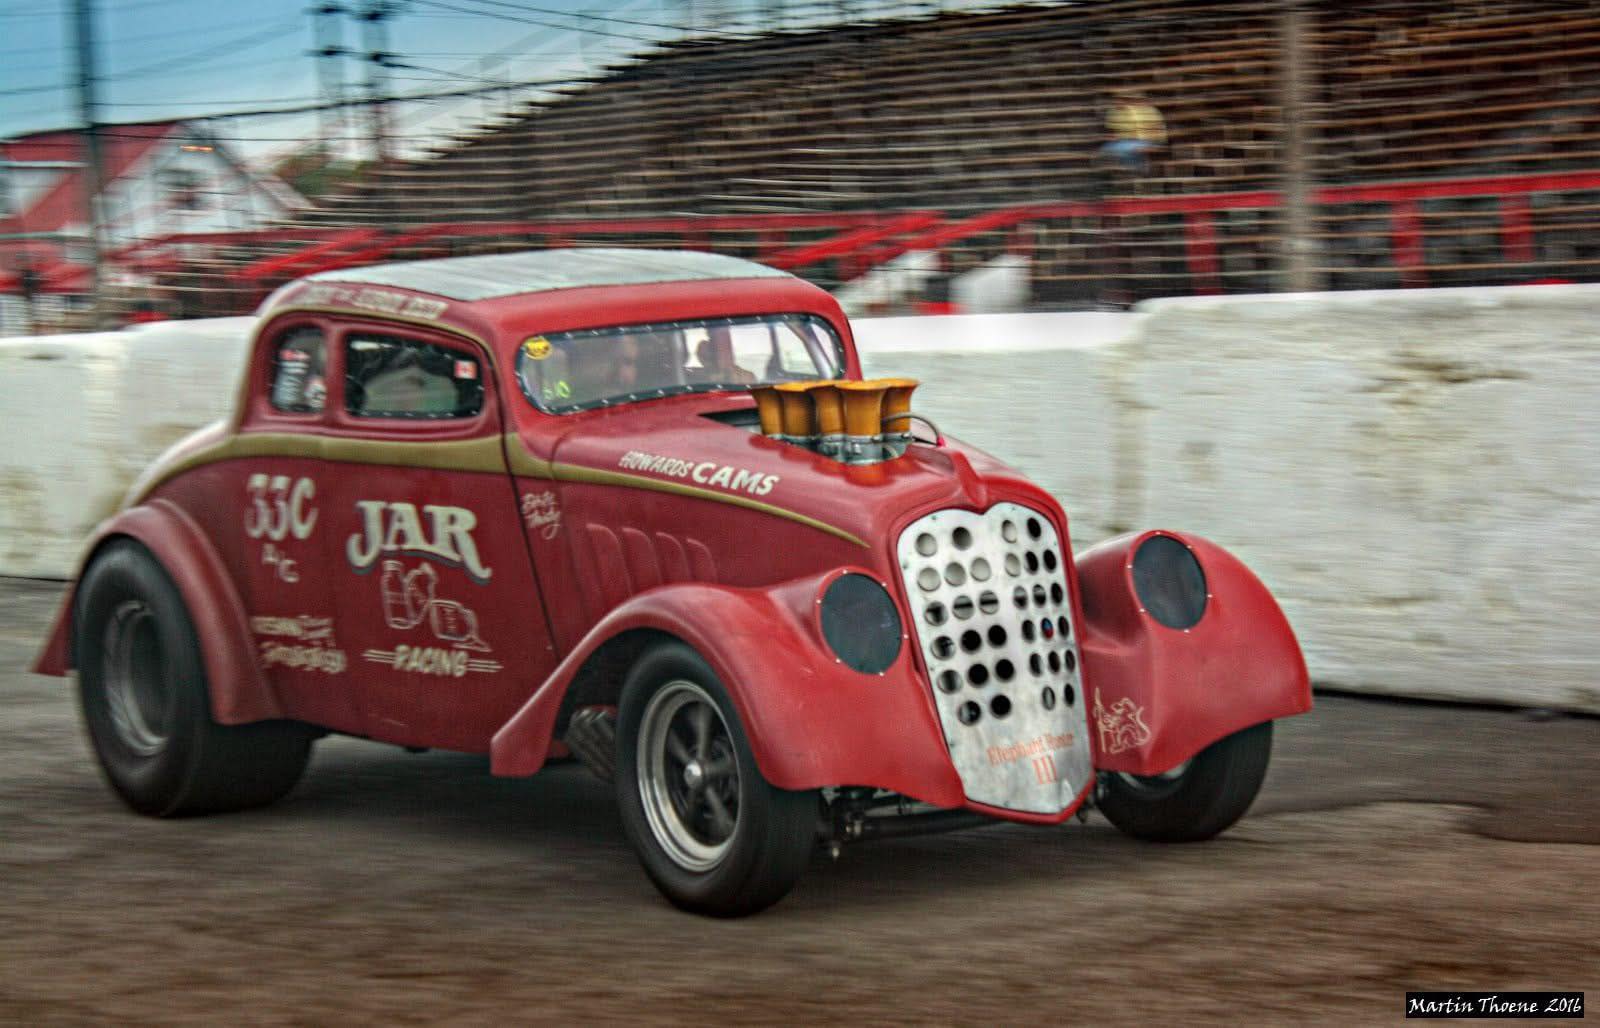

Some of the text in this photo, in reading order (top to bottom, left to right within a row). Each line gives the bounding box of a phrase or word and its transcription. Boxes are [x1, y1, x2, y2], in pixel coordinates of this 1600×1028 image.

[618, 451, 781, 496] HOWARDS CAMS
[244, 473, 318, 541] 33C
[346, 500, 493, 585] JAR
[394, 644, 469, 677] RACING
